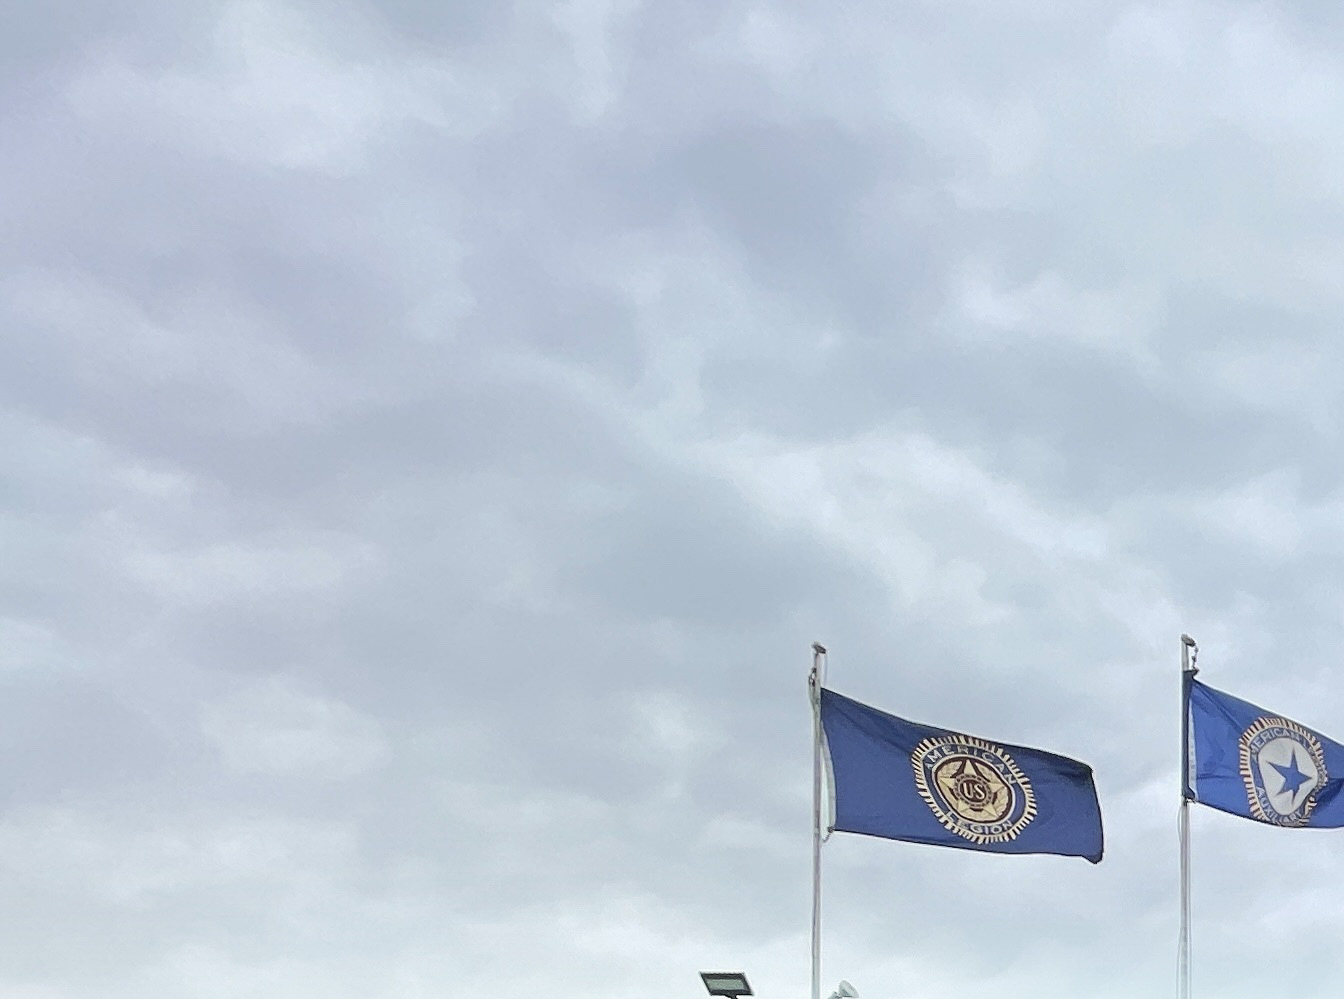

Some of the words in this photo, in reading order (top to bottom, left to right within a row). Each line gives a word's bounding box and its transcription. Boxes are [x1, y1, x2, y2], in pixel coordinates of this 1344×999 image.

[924, 745, 1017, 785] AMERICAN
[962, 782, 985, 800] US
[945, 810, 1013, 835] LEGION
